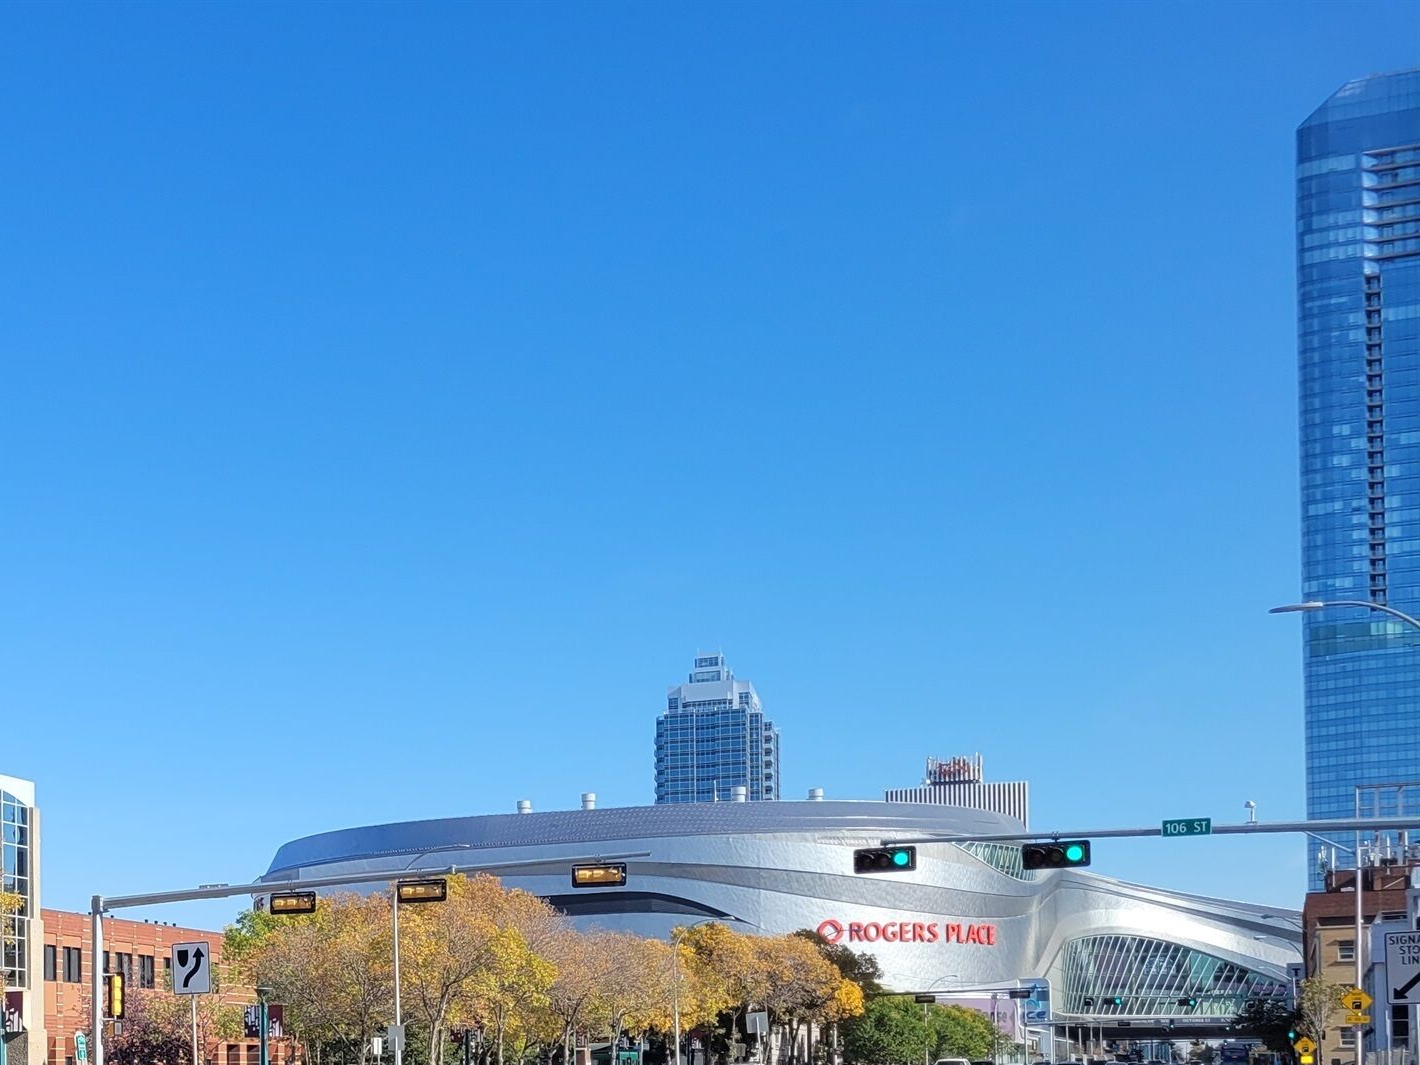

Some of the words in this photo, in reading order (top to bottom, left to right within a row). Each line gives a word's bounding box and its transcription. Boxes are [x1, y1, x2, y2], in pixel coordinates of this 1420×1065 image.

[1165, 822, 1187, 834] 106
[1193, 821, 1207, 833] ST
[848, 922, 939, 943] ROGERS
[945, 923, 997, 946] PLACE
